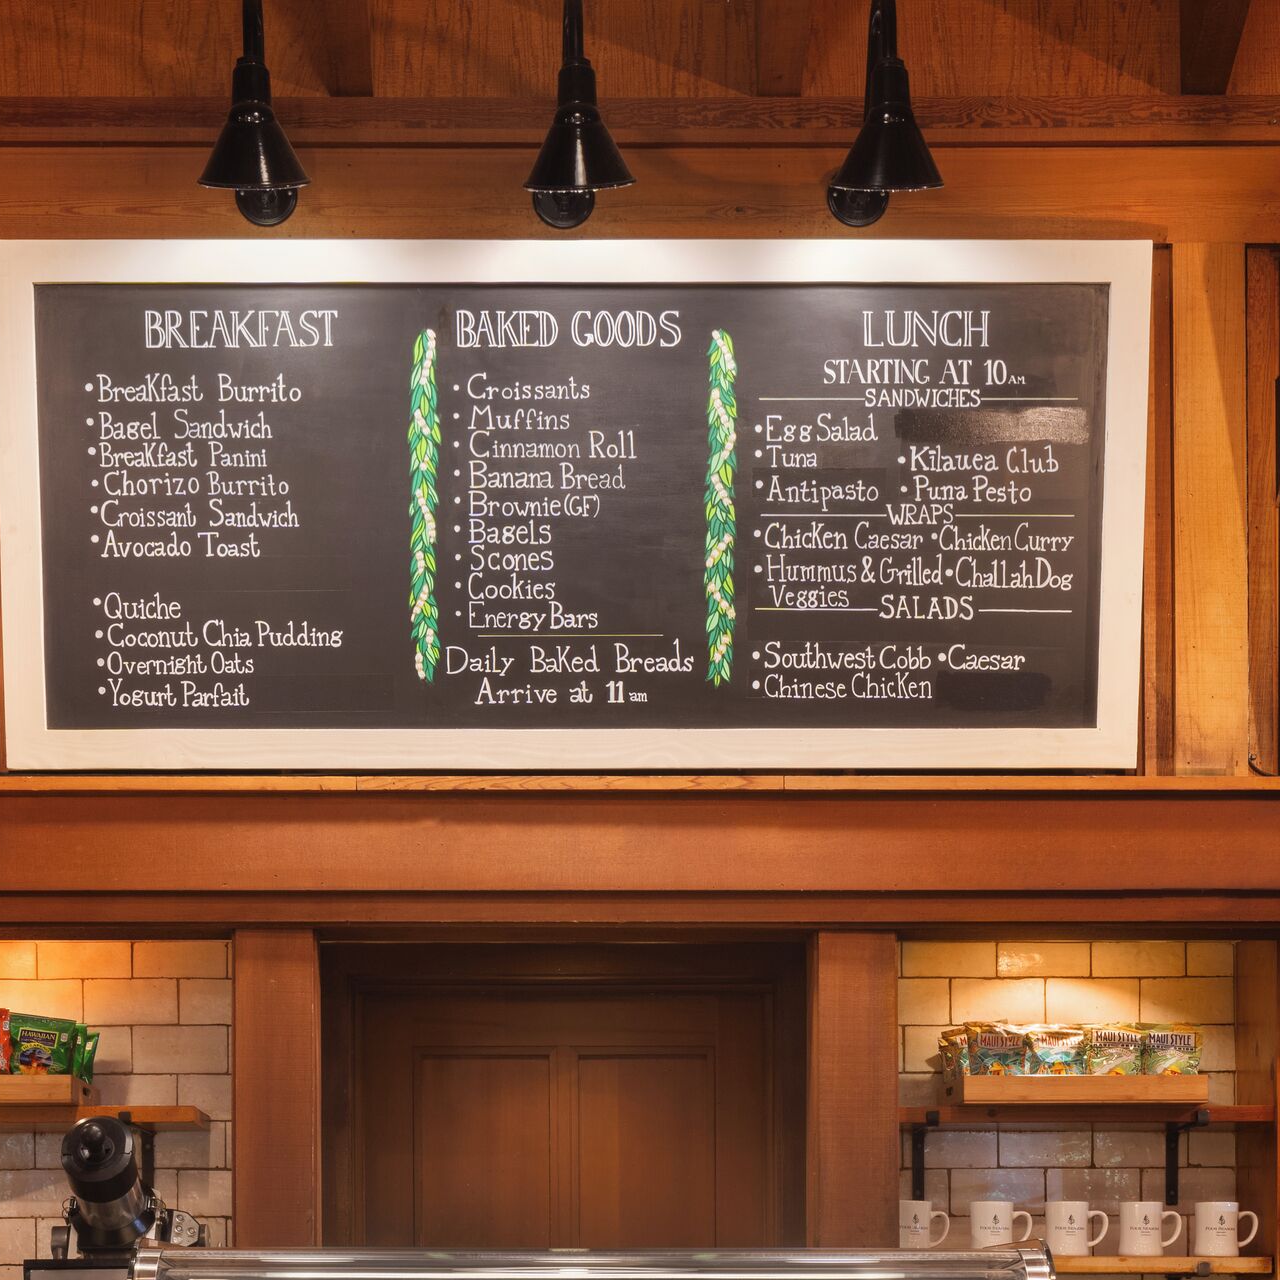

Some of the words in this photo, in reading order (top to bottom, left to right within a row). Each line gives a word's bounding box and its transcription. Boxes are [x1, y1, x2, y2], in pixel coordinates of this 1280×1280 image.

[144, 310, 338, 349] BREAKFAST
[456, 310, 559, 348] BAKED
[571, 310, 682, 347] GOODS
[862, 310, 990, 347] LUNCH
[823, 359, 930, 385] STARTING
[939, 359, 972, 385] AT
[217, 373, 302, 403] Burrito
[467, 373, 590, 400] Croissants
[865, 388, 981, 408] SANDWICHES
[98, 411, 161, 440] Bagel
[174, 409, 273, 440] Sandwich
[468, 405, 570, 430] Muffins
[766, 415, 813, 442] Egg
[817, 413, 878, 442] Salad
[469, 431, 581, 458] Cinnamon
[588, 430, 638, 459] Roll
[766, 445, 817, 468] Tuna
[104, 470, 200, 497] Chorizo
[206, 471, 289, 497] Burrito
[468, 461, 554, 489] Banana
[559, 462, 626, 489] Bread
[766, 475, 879, 512] Antipasto
[913, 475, 968, 503] Puna
[972, 476, 1032, 505] Pesto
[100, 499, 197, 528] Croissant
[209, 499, 300, 528] Sandwich
[885, 504, 954, 526] WRAPS
[101, 529, 192, 558] Avocado
[198, 532, 261, 558] Toast
[468, 519, 552, 545] Bagels
[854, 522, 924, 550] Caesar
[471, 544, 554, 571] Scones
[468, 572, 556, 600] Cookies
[104, 591, 181, 620] Quiche
[879, 594, 974, 620] SALADS
[107, 621, 198, 648] Coconut
[203, 619, 252, 647] Chia
[255, 620, 343, 648] Pudding
[445, 646, 515, 677] Daily
[614, 638, 694, 673] Breads
[764, 641, 876, 670] Southwest
[879, 646, 932, 670] Cobb
[948, 644, 1026, 671] Caesar
[108, 678, 176, 707] Yogurt
[181, 681, 250, 707] Parfait
[474, 677, 557, 705] Arrive
[569, 680, 593, 704] at
[605, 681, 625, 703] 11
[629, 691, 647, 703] am
[764, 674, 845, 699] Chinese
[1149, 1033, 1169, 1043] MAUI
[1171, 1034, 1191, 1045] STYLE
